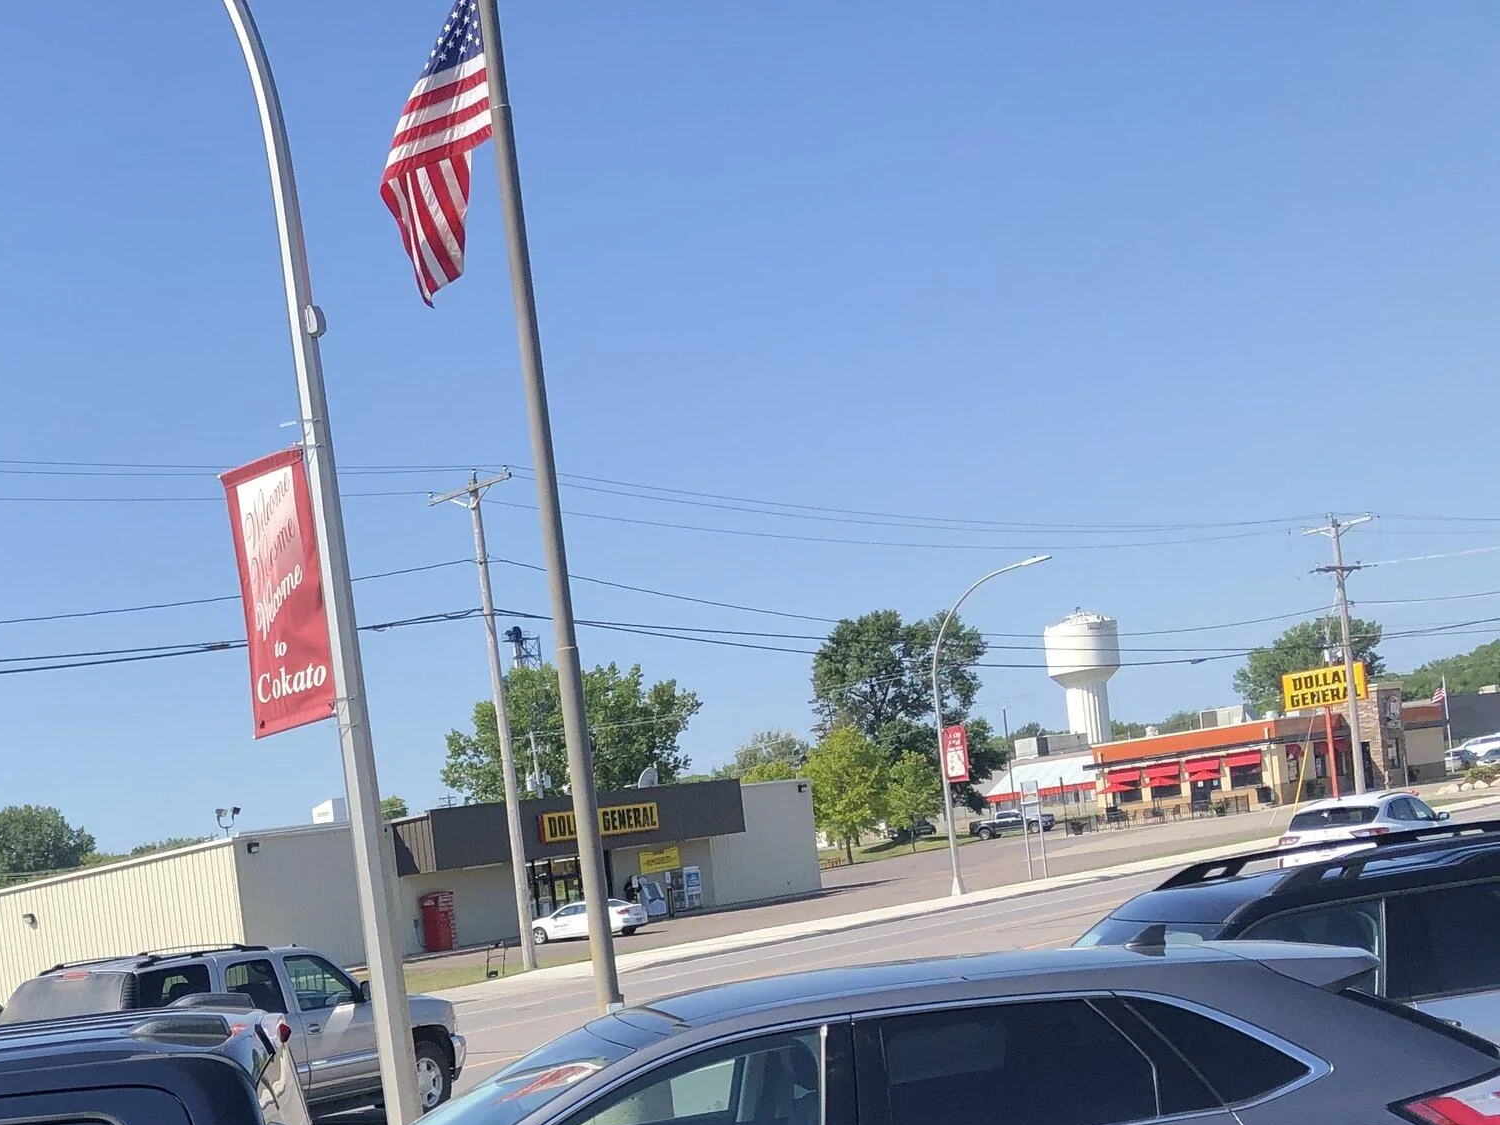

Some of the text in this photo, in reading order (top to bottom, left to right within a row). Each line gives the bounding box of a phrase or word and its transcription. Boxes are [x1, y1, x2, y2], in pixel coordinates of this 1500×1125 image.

[255, 563, 303, 641] Welcome
[275, 639, 287, 658] to
[257, 663, 327, 704] Cokato
[602, 806, 656, 831] GENERAL
